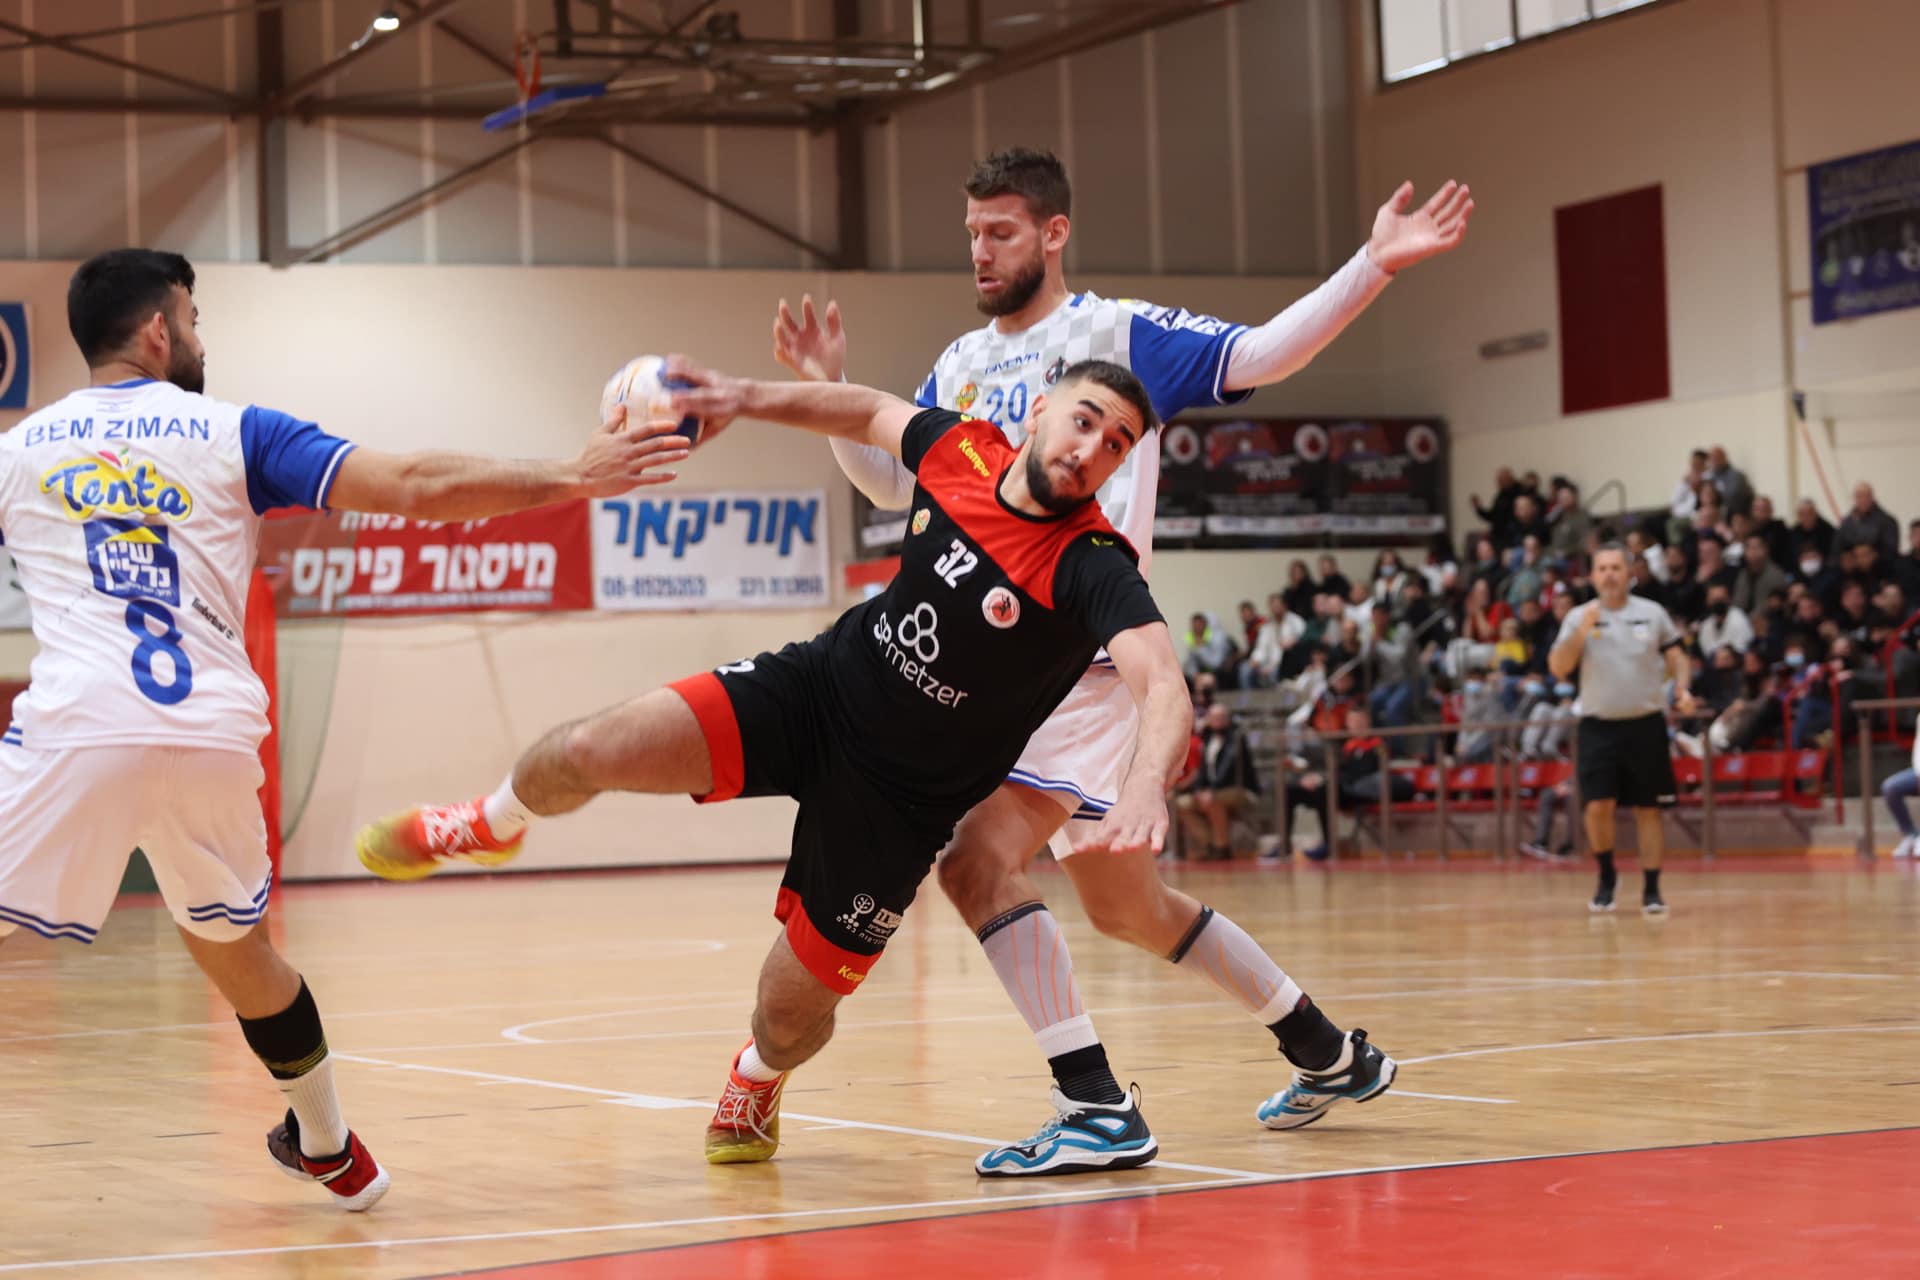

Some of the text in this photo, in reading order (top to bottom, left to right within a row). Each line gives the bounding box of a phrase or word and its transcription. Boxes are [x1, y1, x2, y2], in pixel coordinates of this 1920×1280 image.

[104, 416, 209, 440] ZIMAN
[986, 382, 1028, 427] 20
[957, 437, 991, 478] Kempa
[45, 463, 188, 516] Tenta
[602, 499, 819, 558] אוריקאר
[292, 542, 557, 611] מיסטר פיקס
[933, 539, 978, 589] 32
[125, 600, 192, 704] 8
